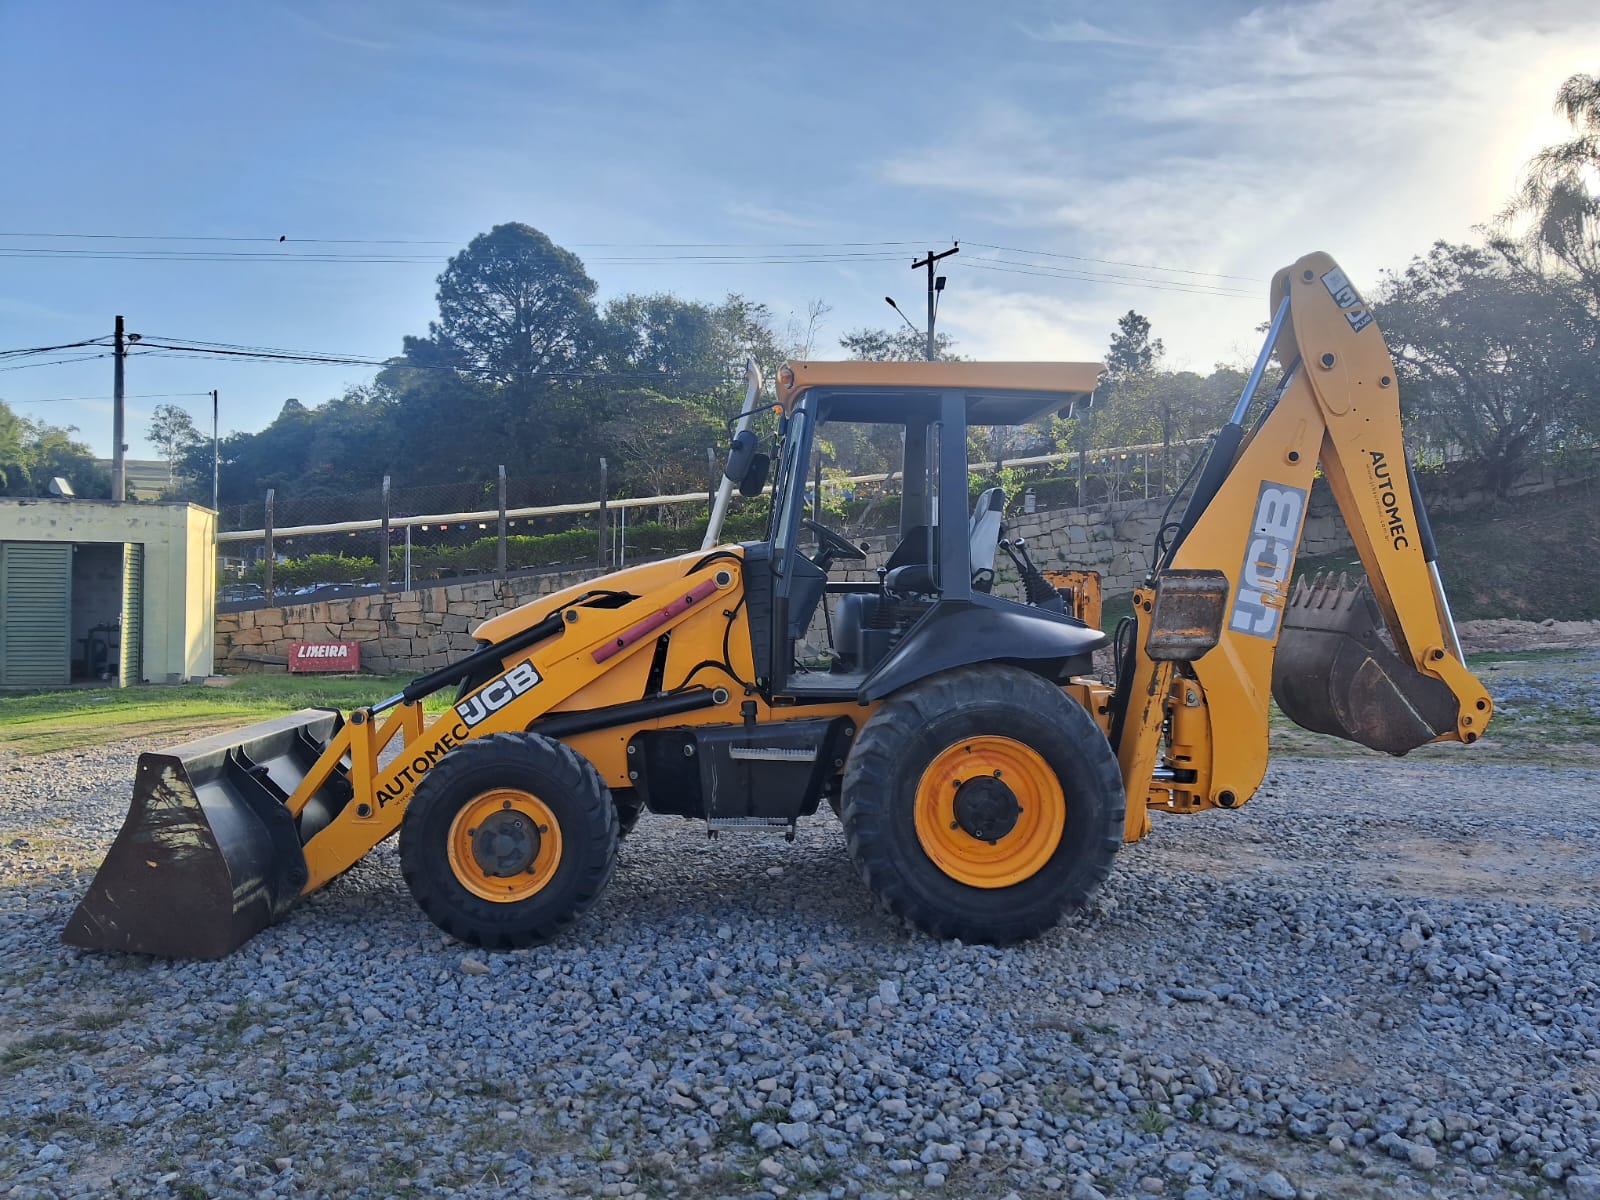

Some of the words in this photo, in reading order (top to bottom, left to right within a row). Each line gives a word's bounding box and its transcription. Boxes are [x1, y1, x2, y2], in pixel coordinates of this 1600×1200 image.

[1369, 451, 1409, 551] AUTOMEC
[1231, 488, 1302, 634] JCB
[297, 645, 348, 658] LIXEIRA
[456, 662, 539, 726] JCB
[375, 723, 470, 809] AUTOMEC
